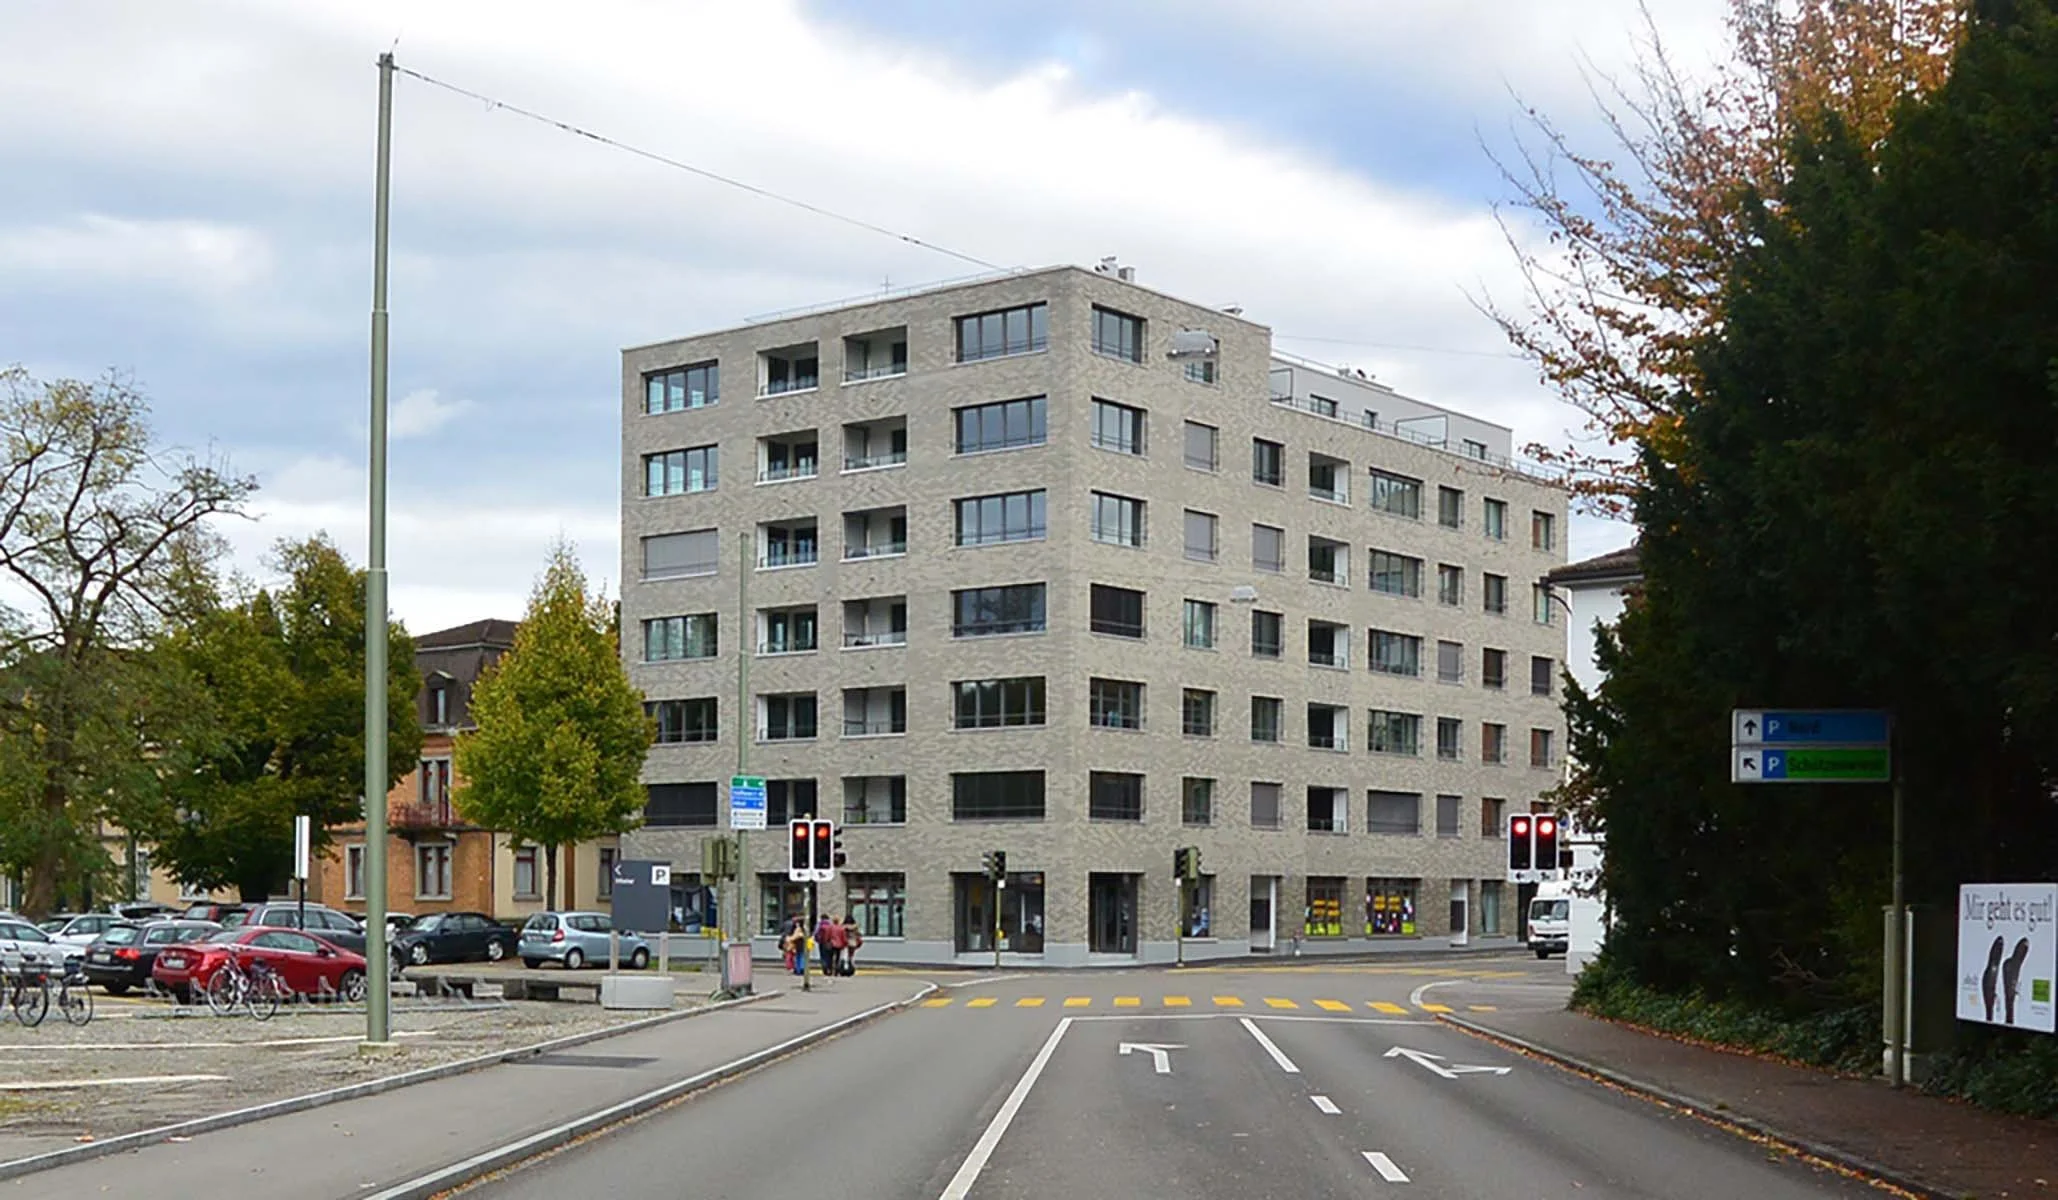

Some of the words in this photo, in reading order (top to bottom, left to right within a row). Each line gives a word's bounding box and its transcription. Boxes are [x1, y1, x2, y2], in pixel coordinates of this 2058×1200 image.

[1768, 719, 1780, 735] P
[1768, 756, 1780, 772] P
[655, 868, 667, 882] P
[1986, 891, 2011, 930] geht
[2013, 901, 2025, 921] es
